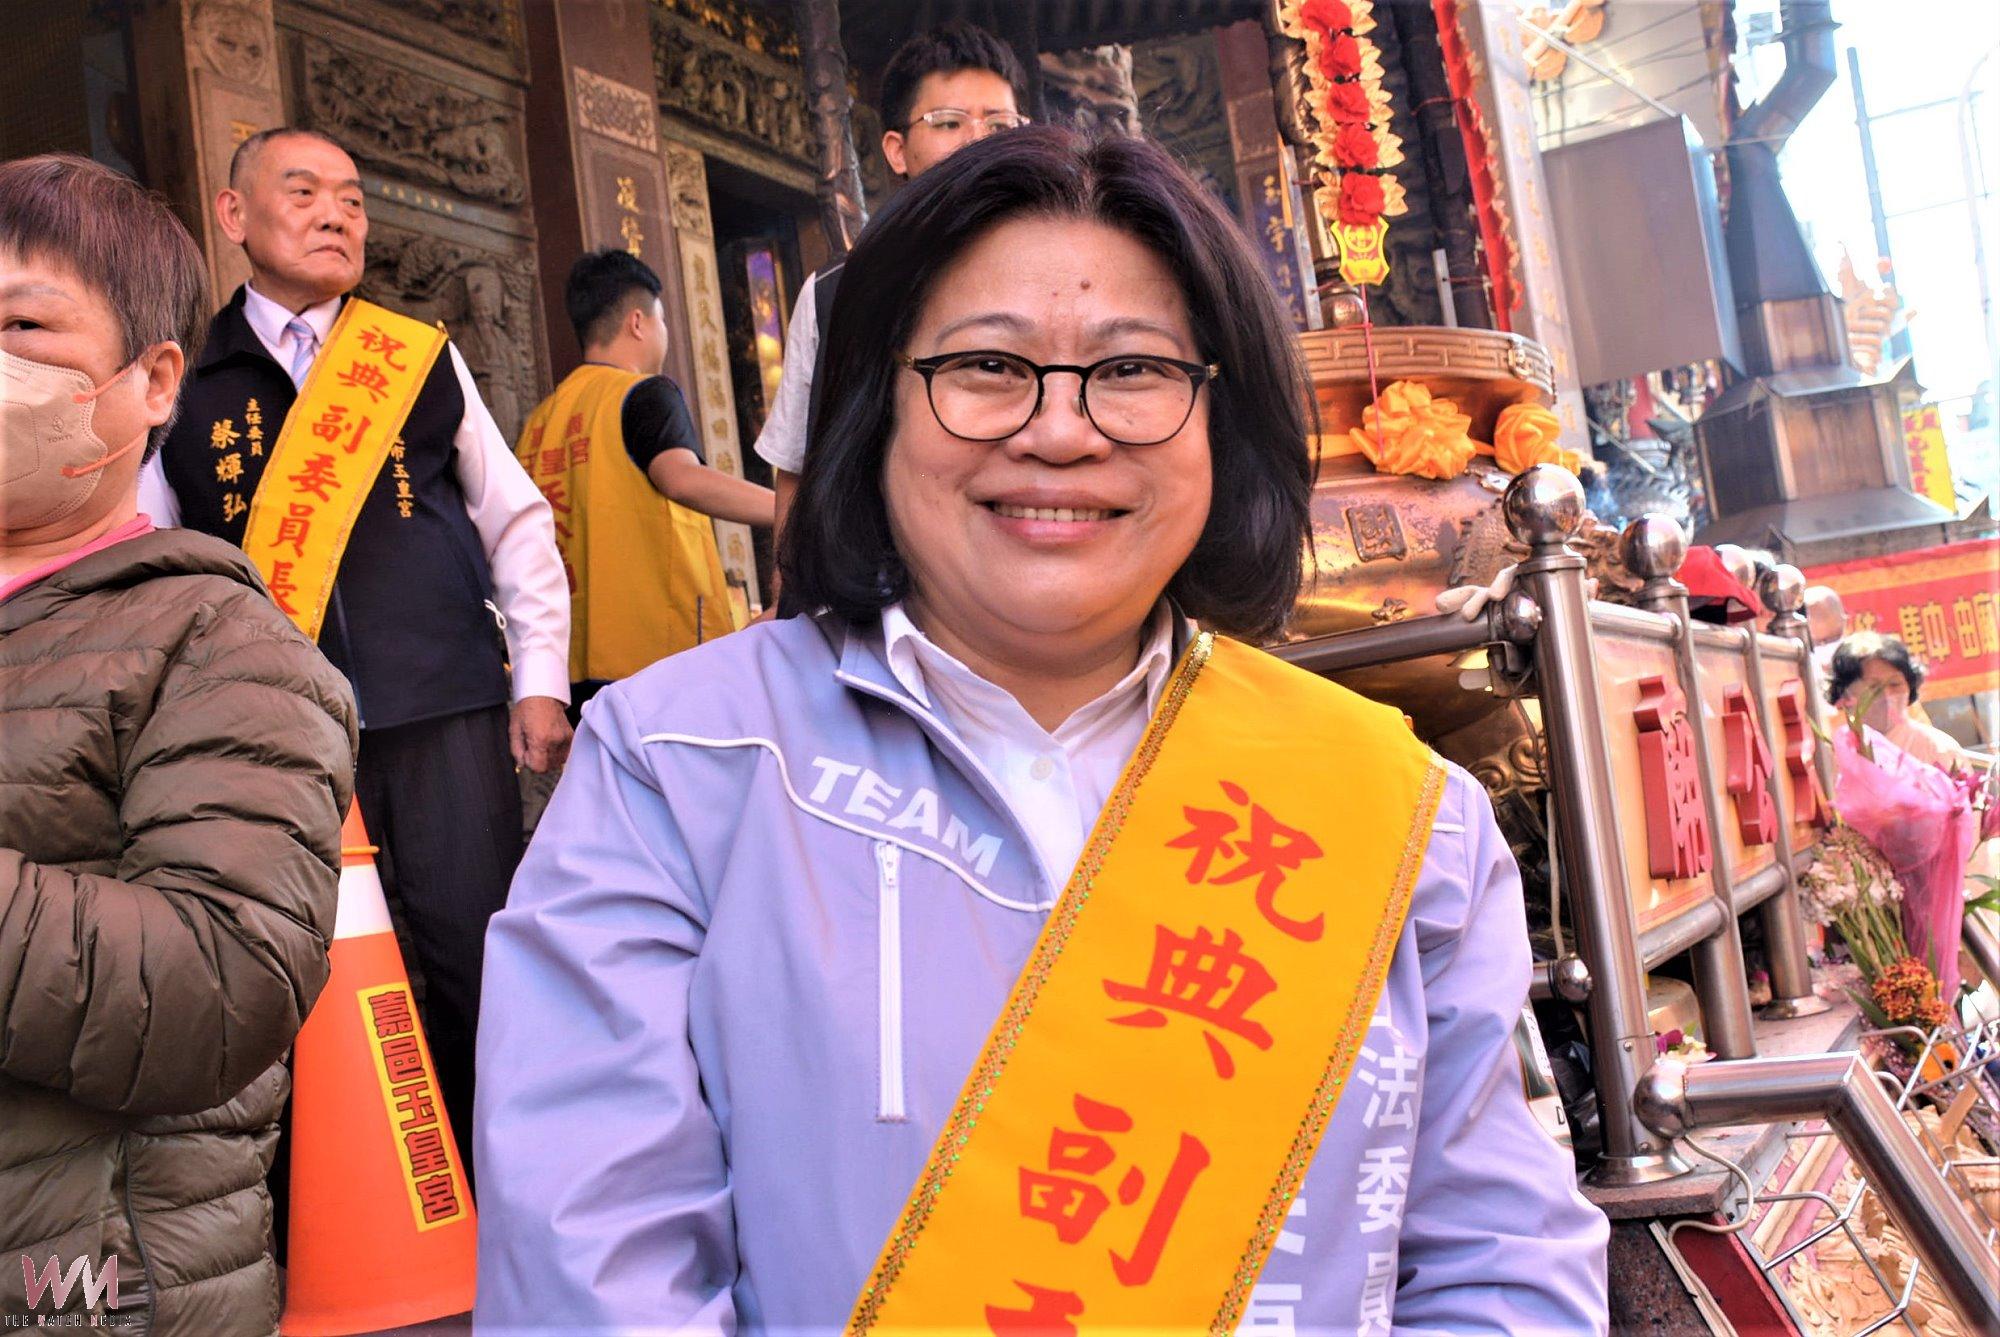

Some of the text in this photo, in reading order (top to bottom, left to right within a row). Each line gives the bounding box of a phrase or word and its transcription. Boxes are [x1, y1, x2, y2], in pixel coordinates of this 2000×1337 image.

[267, 324, 407, 616] 祝典副委員長
[390, 431, 415, 518] 市玉皇宮
[809, 756, 1004, 878] TEAM
[367, 990, 460, 1224] 嘉邑玉皇宮
